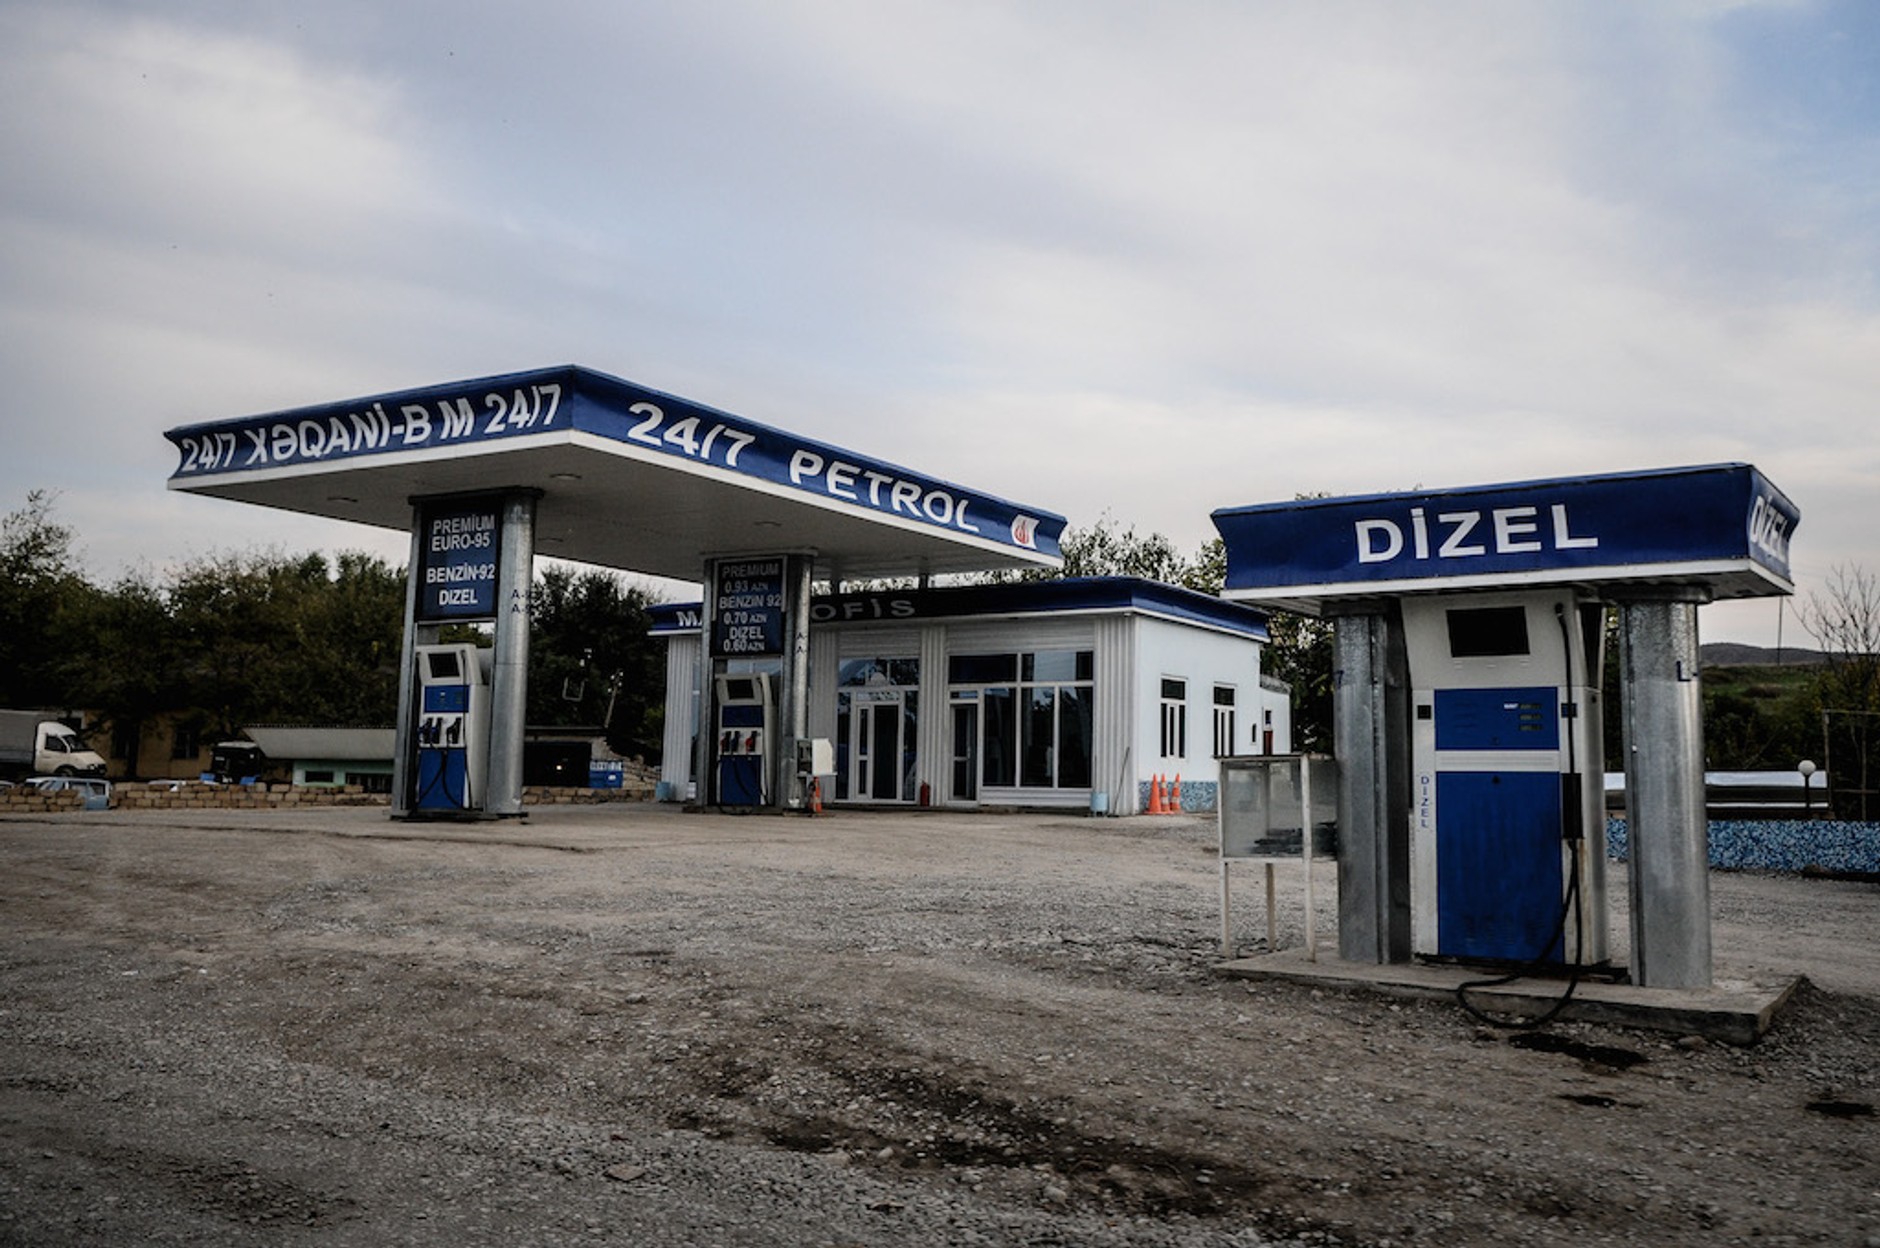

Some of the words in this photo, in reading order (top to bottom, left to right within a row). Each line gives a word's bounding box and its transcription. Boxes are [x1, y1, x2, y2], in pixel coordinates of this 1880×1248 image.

[181, 422, 237, 472] 24/7
[245, 402, 432, 466] XƏQANİ-B
[437, 397, 475, 440] M
[484, 383, 561, 434] 24/7
[628, 402, 755, 467] 24/7
[789, 449, 980, 533] PETROL
[432, 532, 491, 552] EURO-95
[1355, 503, 1599, 564] DİZEL
[426, 562, 495, 583] BENZİN-92
[766, 593, 781, 607] 92
[675, 608, 703, 628] M
[723, 611, 748, 625] 0.70
[749, 613, 767, 624] AZN
[748, 641, 765, 651] AZN
